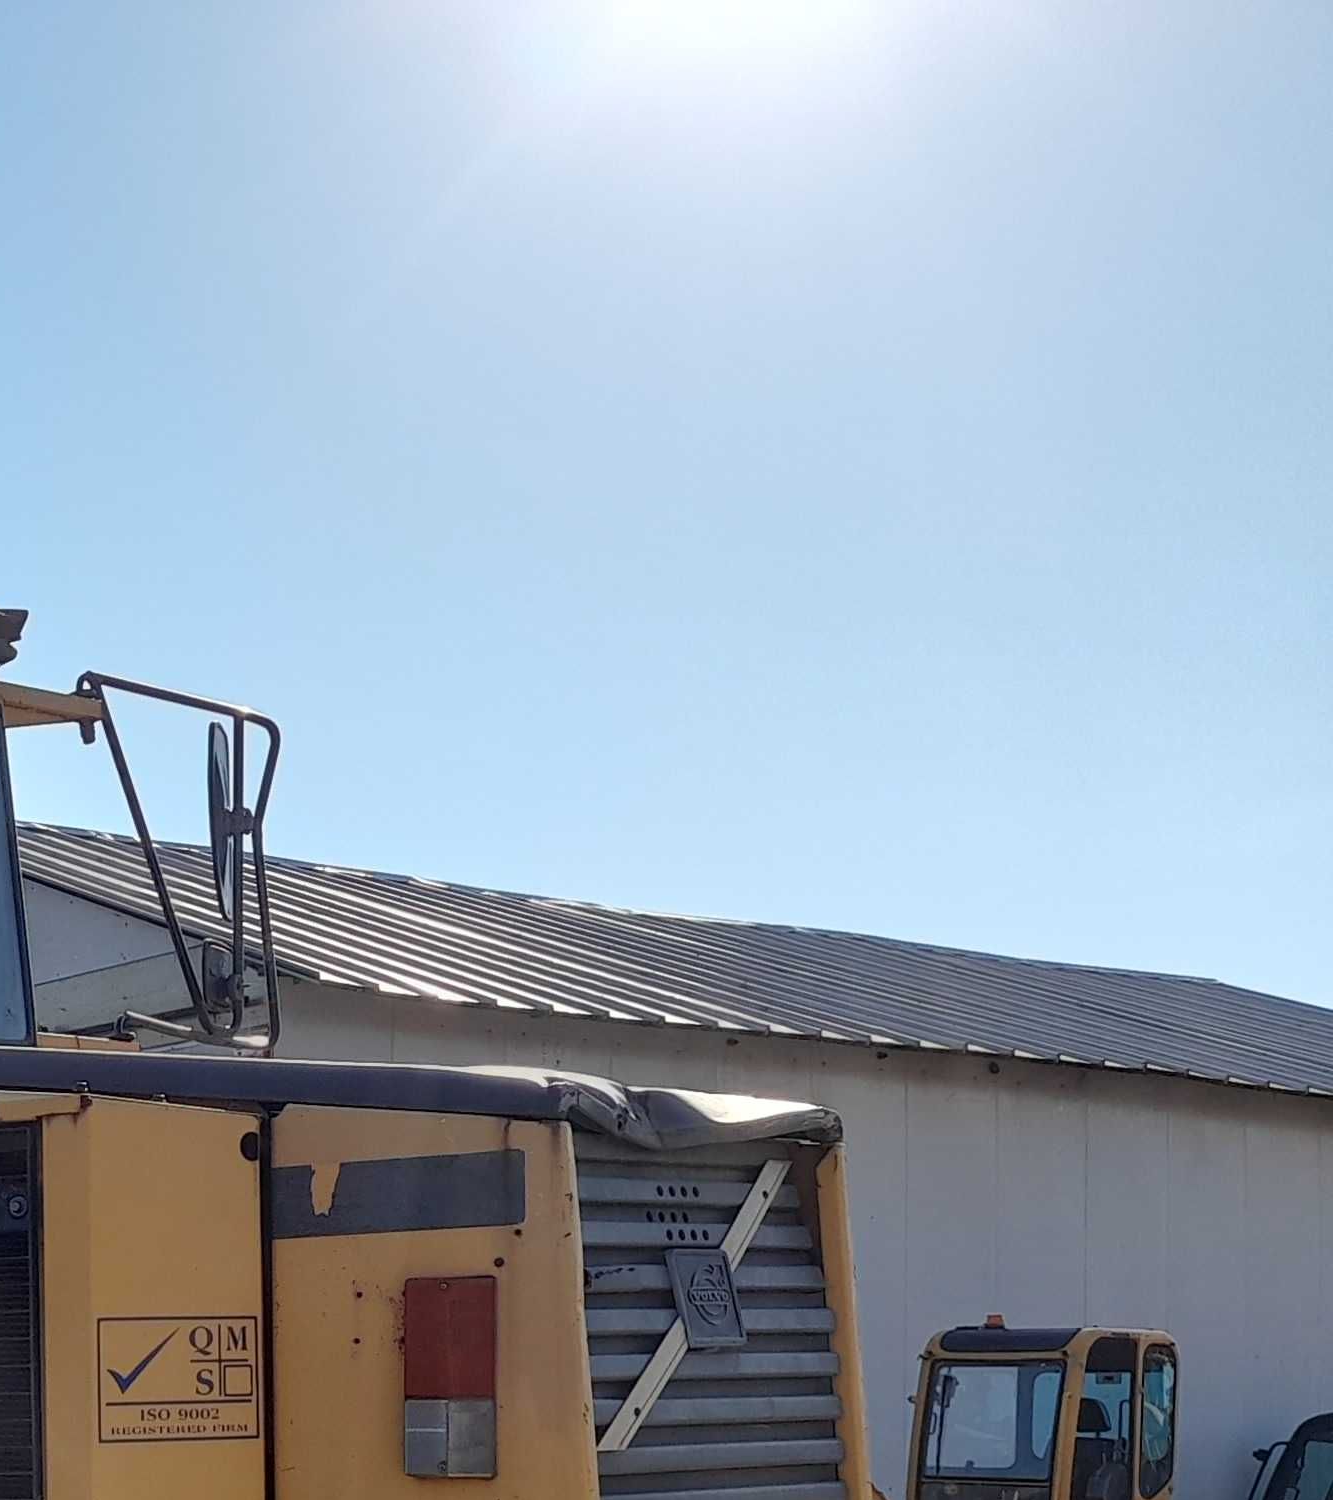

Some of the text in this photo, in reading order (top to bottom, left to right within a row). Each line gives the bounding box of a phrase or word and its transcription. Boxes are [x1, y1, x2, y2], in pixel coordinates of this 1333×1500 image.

[691, 1289, 730, 1302] VOLVO
[140, 1407, 221, 1422] ISO 9002
[111, 1423, 249, 1436] REGISTERED FIRM
